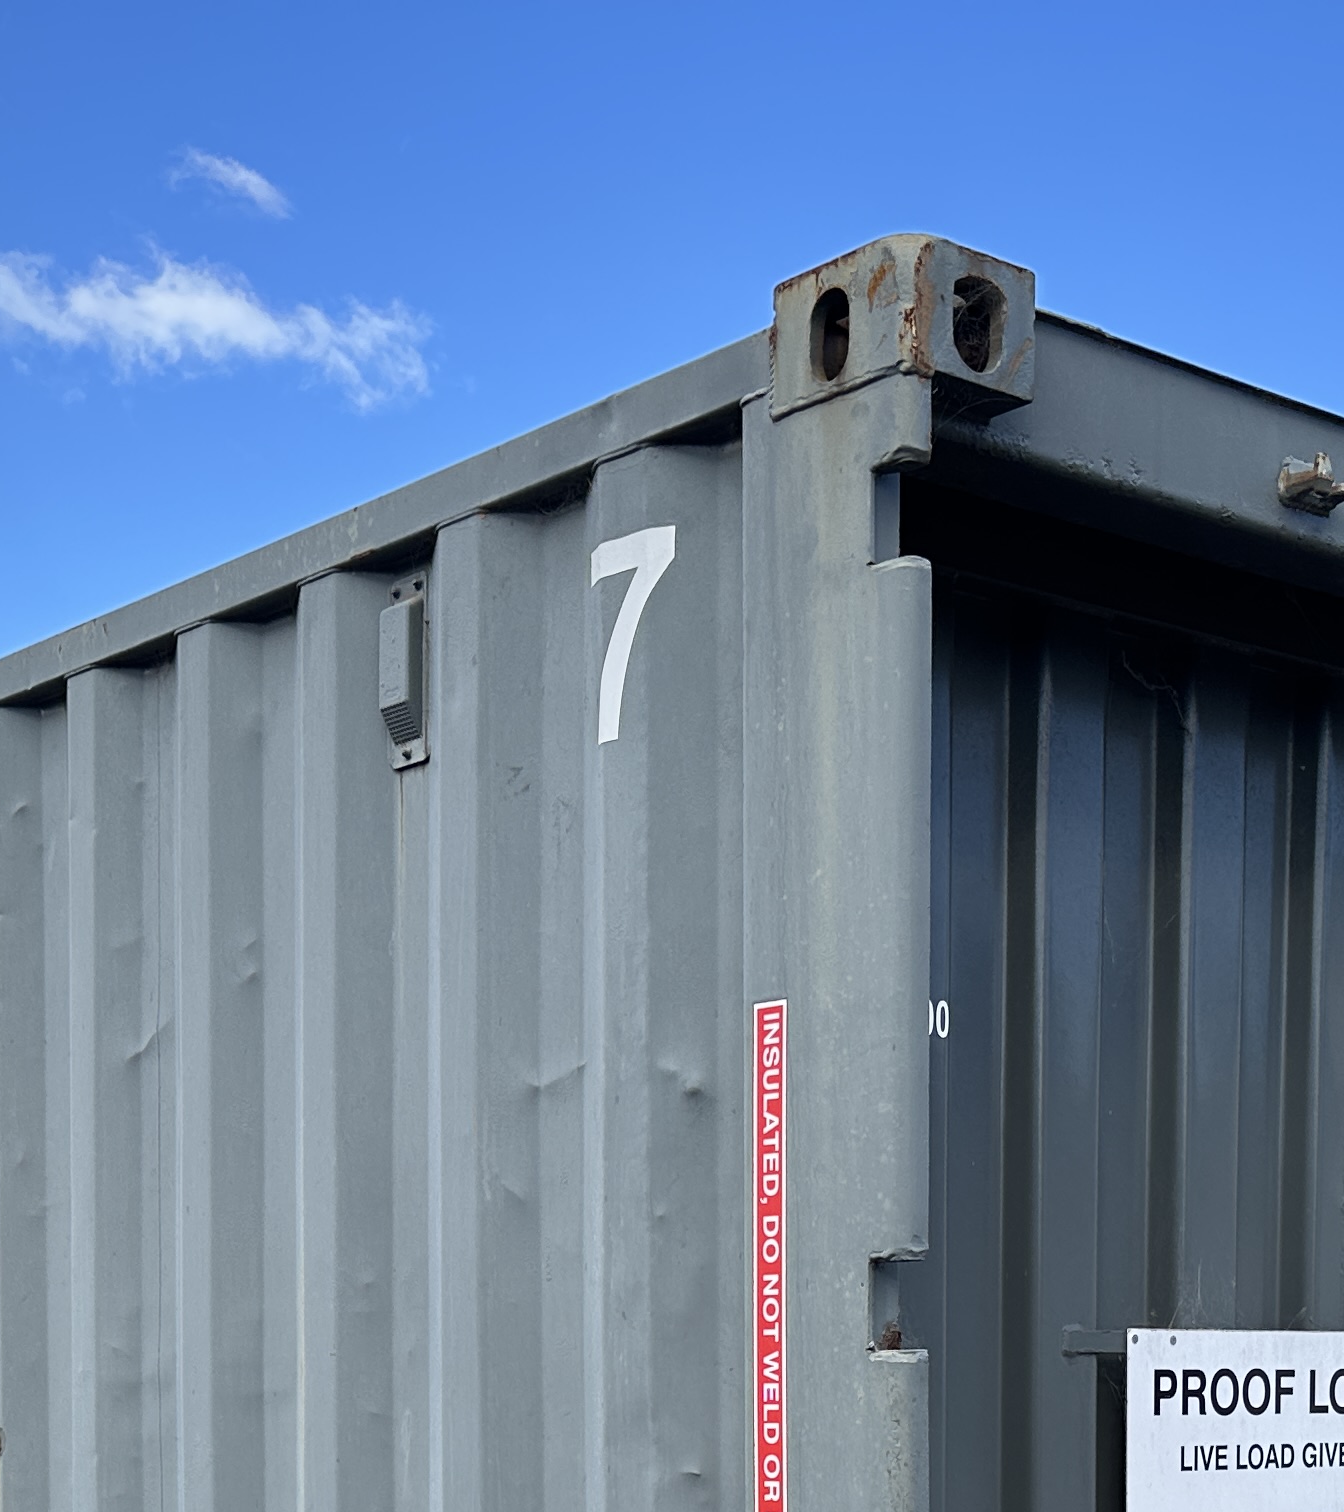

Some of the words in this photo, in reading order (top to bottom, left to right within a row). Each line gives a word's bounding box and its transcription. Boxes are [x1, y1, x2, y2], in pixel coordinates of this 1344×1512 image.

[590, 525, 676, 745] 7
[760, 1012, 781, 1205] INSULATED,
[762, 1215, 781, 1264] DO
[762, 1274, 781, 1343] NOT
[762, 1350, 781, 1445] WELD
[1153, 1368, 1296, 1417] PROOF
[763, 1454, 782, 1502] OR
[1180, 1444, 1228, 1472] LIVE
[1236, 1443, 1295, 1470] LOAD
